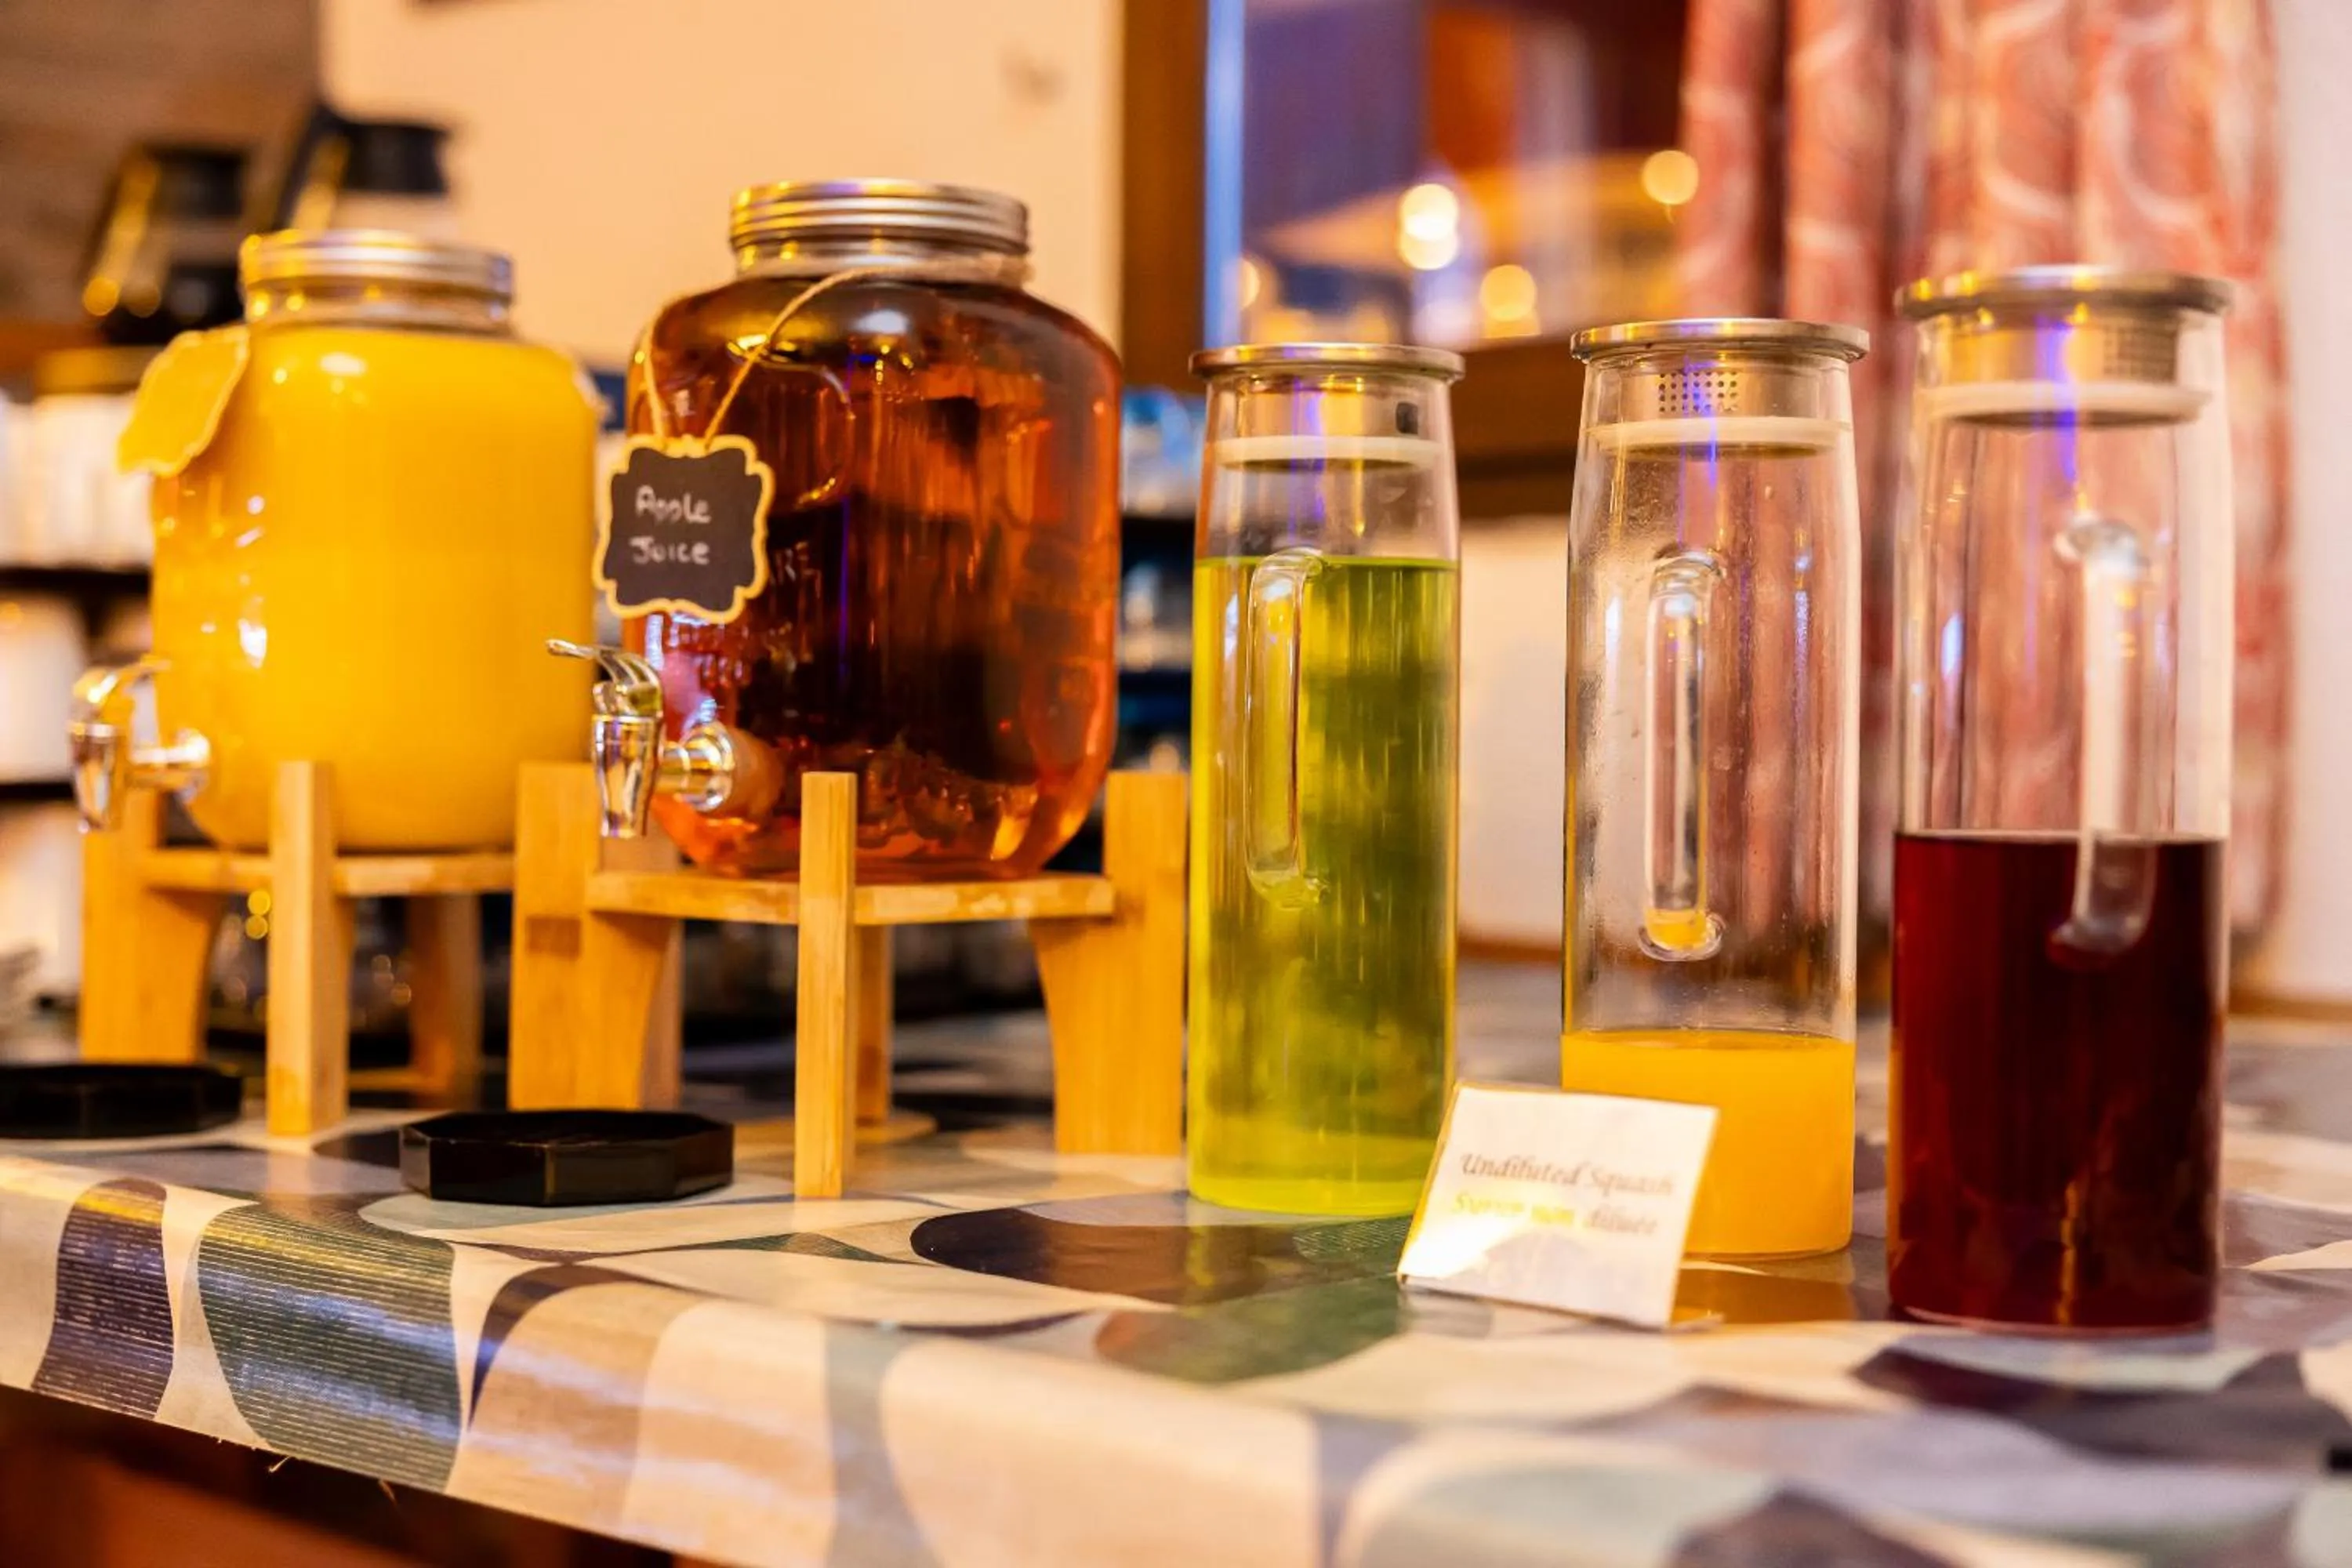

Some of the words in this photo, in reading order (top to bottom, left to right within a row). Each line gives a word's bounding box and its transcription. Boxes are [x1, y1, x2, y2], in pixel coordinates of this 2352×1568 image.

[634, 485, 711, 524] Apple
[630, 535, 710, 565] Juice
[1460, 1152, 1590, 1187] Undiluted
